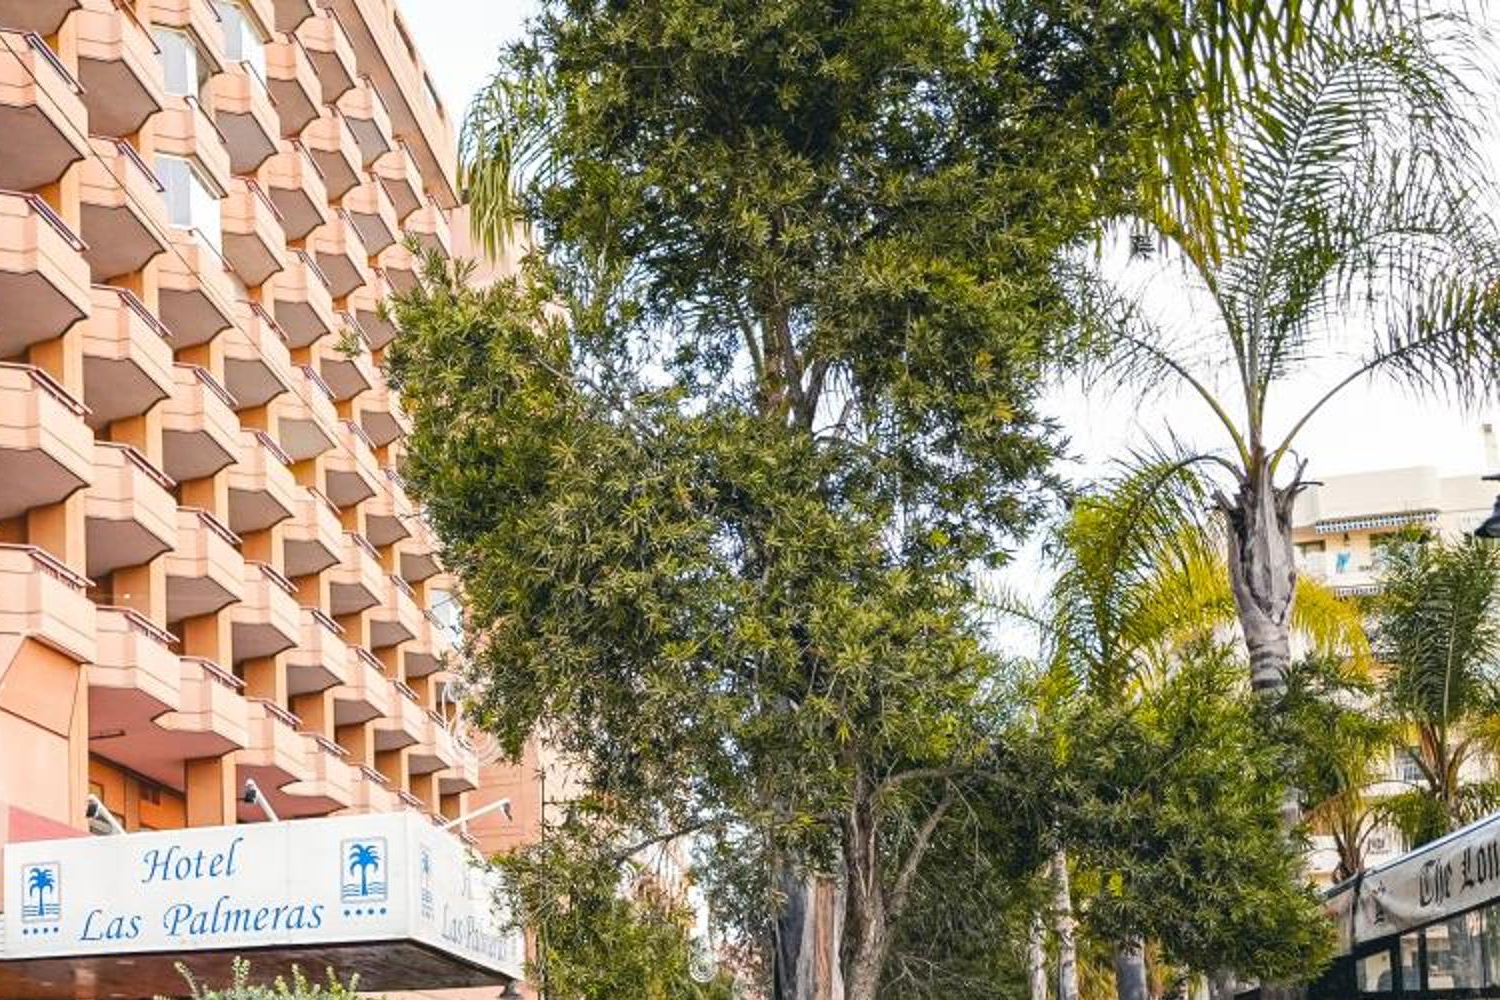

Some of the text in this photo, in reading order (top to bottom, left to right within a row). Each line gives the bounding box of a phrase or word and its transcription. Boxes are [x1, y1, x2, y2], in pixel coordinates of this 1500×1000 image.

[141, 837, 243, 883] Hotel
[80, 895, 324, 941] Las Palmeras
